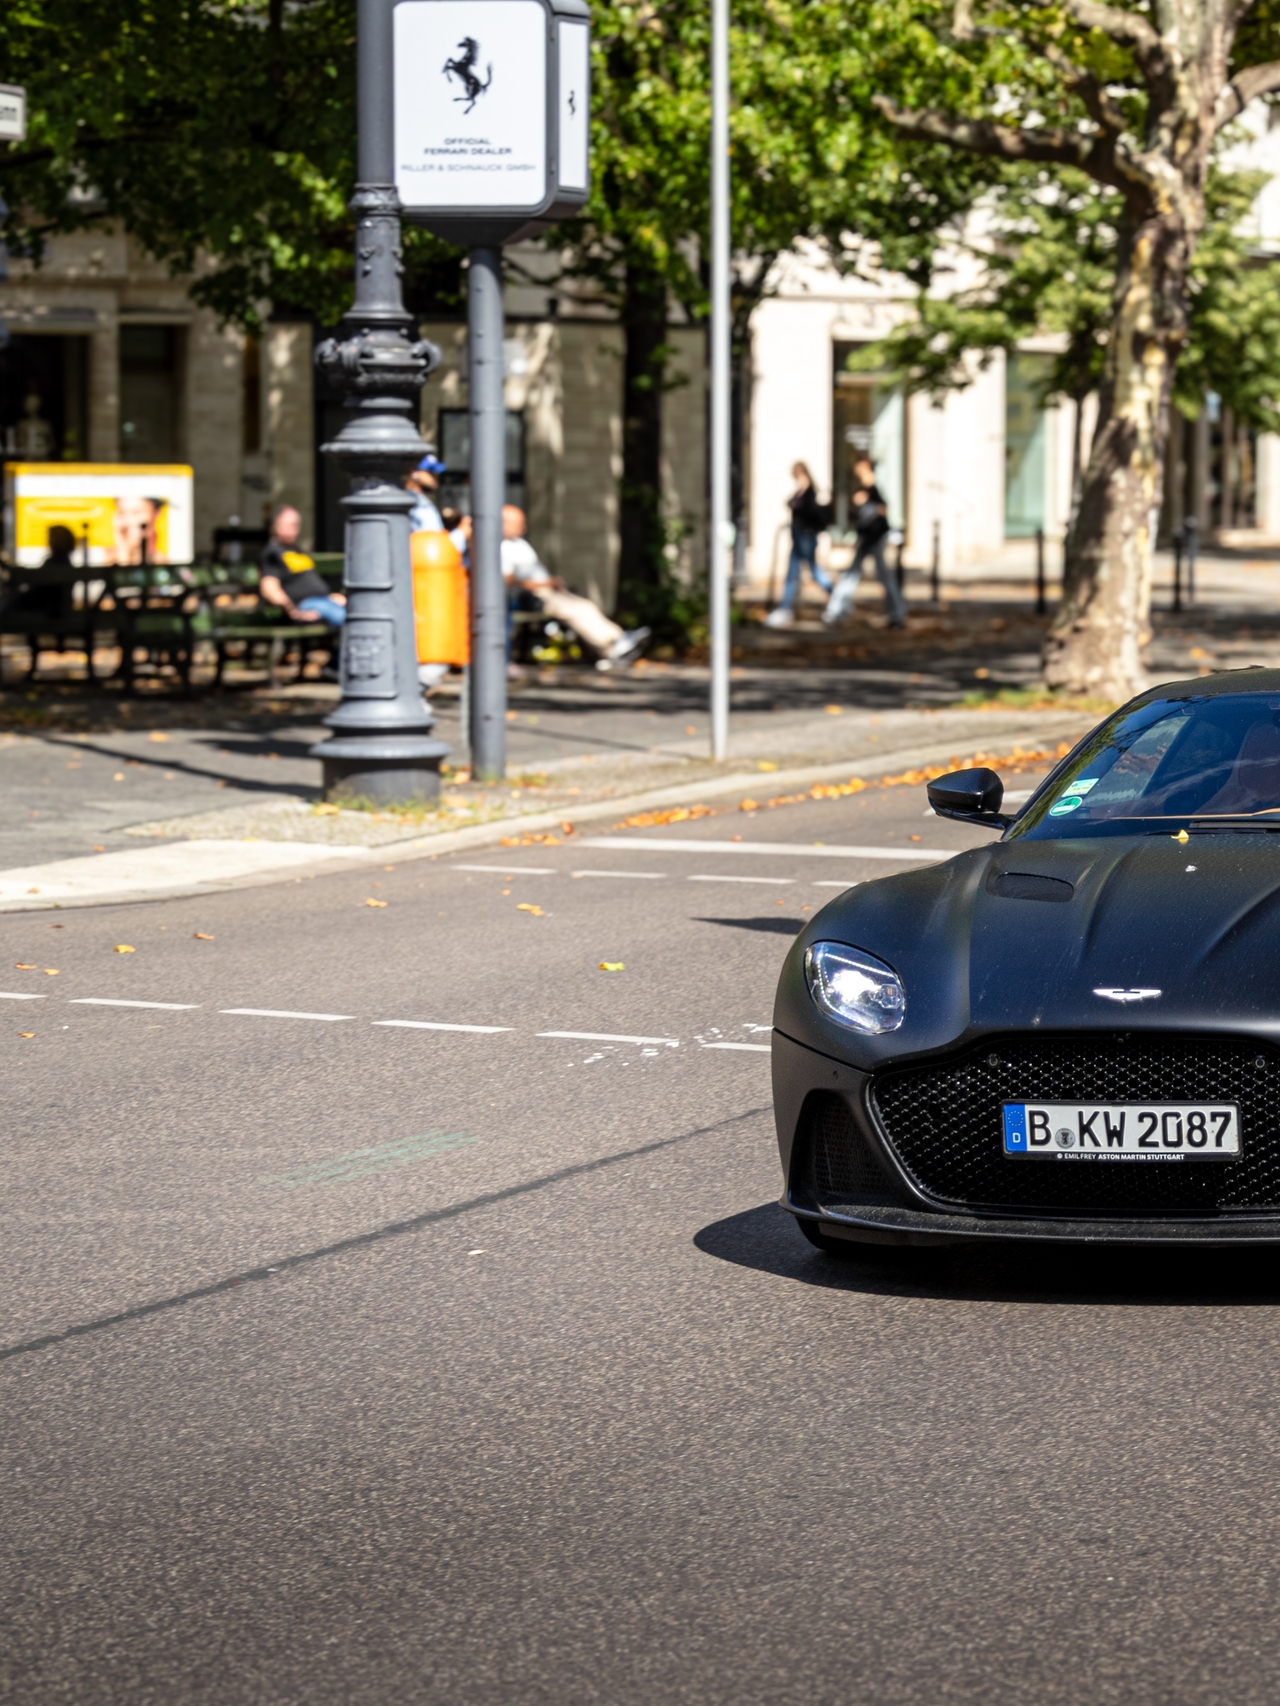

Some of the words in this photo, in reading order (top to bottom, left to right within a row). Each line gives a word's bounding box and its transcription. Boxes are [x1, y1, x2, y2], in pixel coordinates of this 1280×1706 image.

[443, 137, 491, 146] OFFICIAL
[424, 147, 468, 155] FERRARI
[471, 147, 512, 155] DEALER
[438, 164, 444, 172] &
[447, 163, 503, 172] SCHNAUCK
[1028, 1110, 1052, 1146] B
[1078, 1110, 1126, 1148] KW
[1138, 1111, 1232, 1148] 2087
[1012, 1132, 1021, 1143] D
